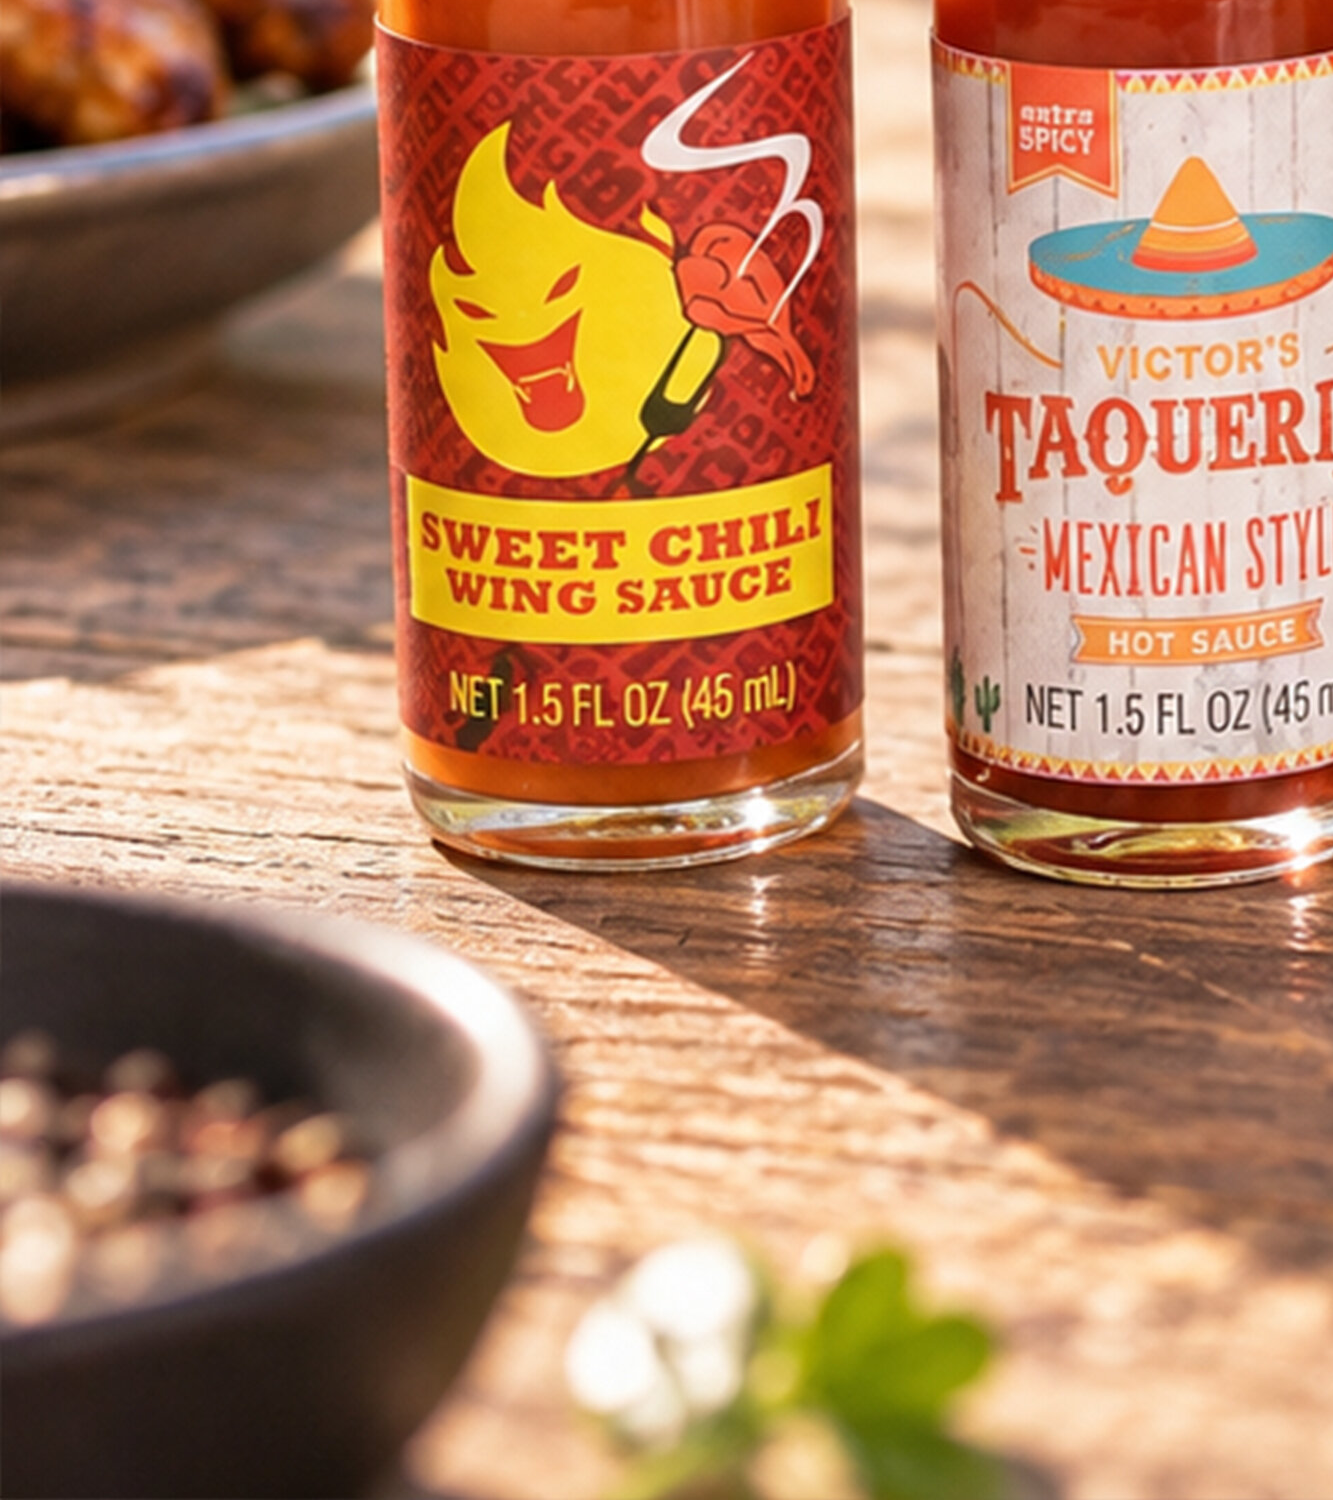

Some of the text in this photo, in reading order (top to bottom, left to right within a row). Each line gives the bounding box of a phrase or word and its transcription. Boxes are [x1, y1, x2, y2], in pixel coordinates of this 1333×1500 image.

[1019, 125, 1095, 156] SPICY
[1097, 332, 1300, 382] VICTOR'S
[420, 498, 821, 570] SWEET CHILI
[1042, 515, 1227, 598] MEXICAN
[445, 556, 792, 616] WING SAUCE
[1107, 618, 1298, 657] HOT SAUCE
[448, 669, 503, 721] NET
[512, 681, 564, 727] 1.5
[573, 684, 614, 727] FL
[624, 681, 673, 727] OZ
[682, 672, 735, 729] (45
[1026, 682, 1084, 731] NET
[1095, 693, 1144, 736] 1.5
[1157, 694, 1196, 736] FL
[1207, 688, 1252, 734] OZ
